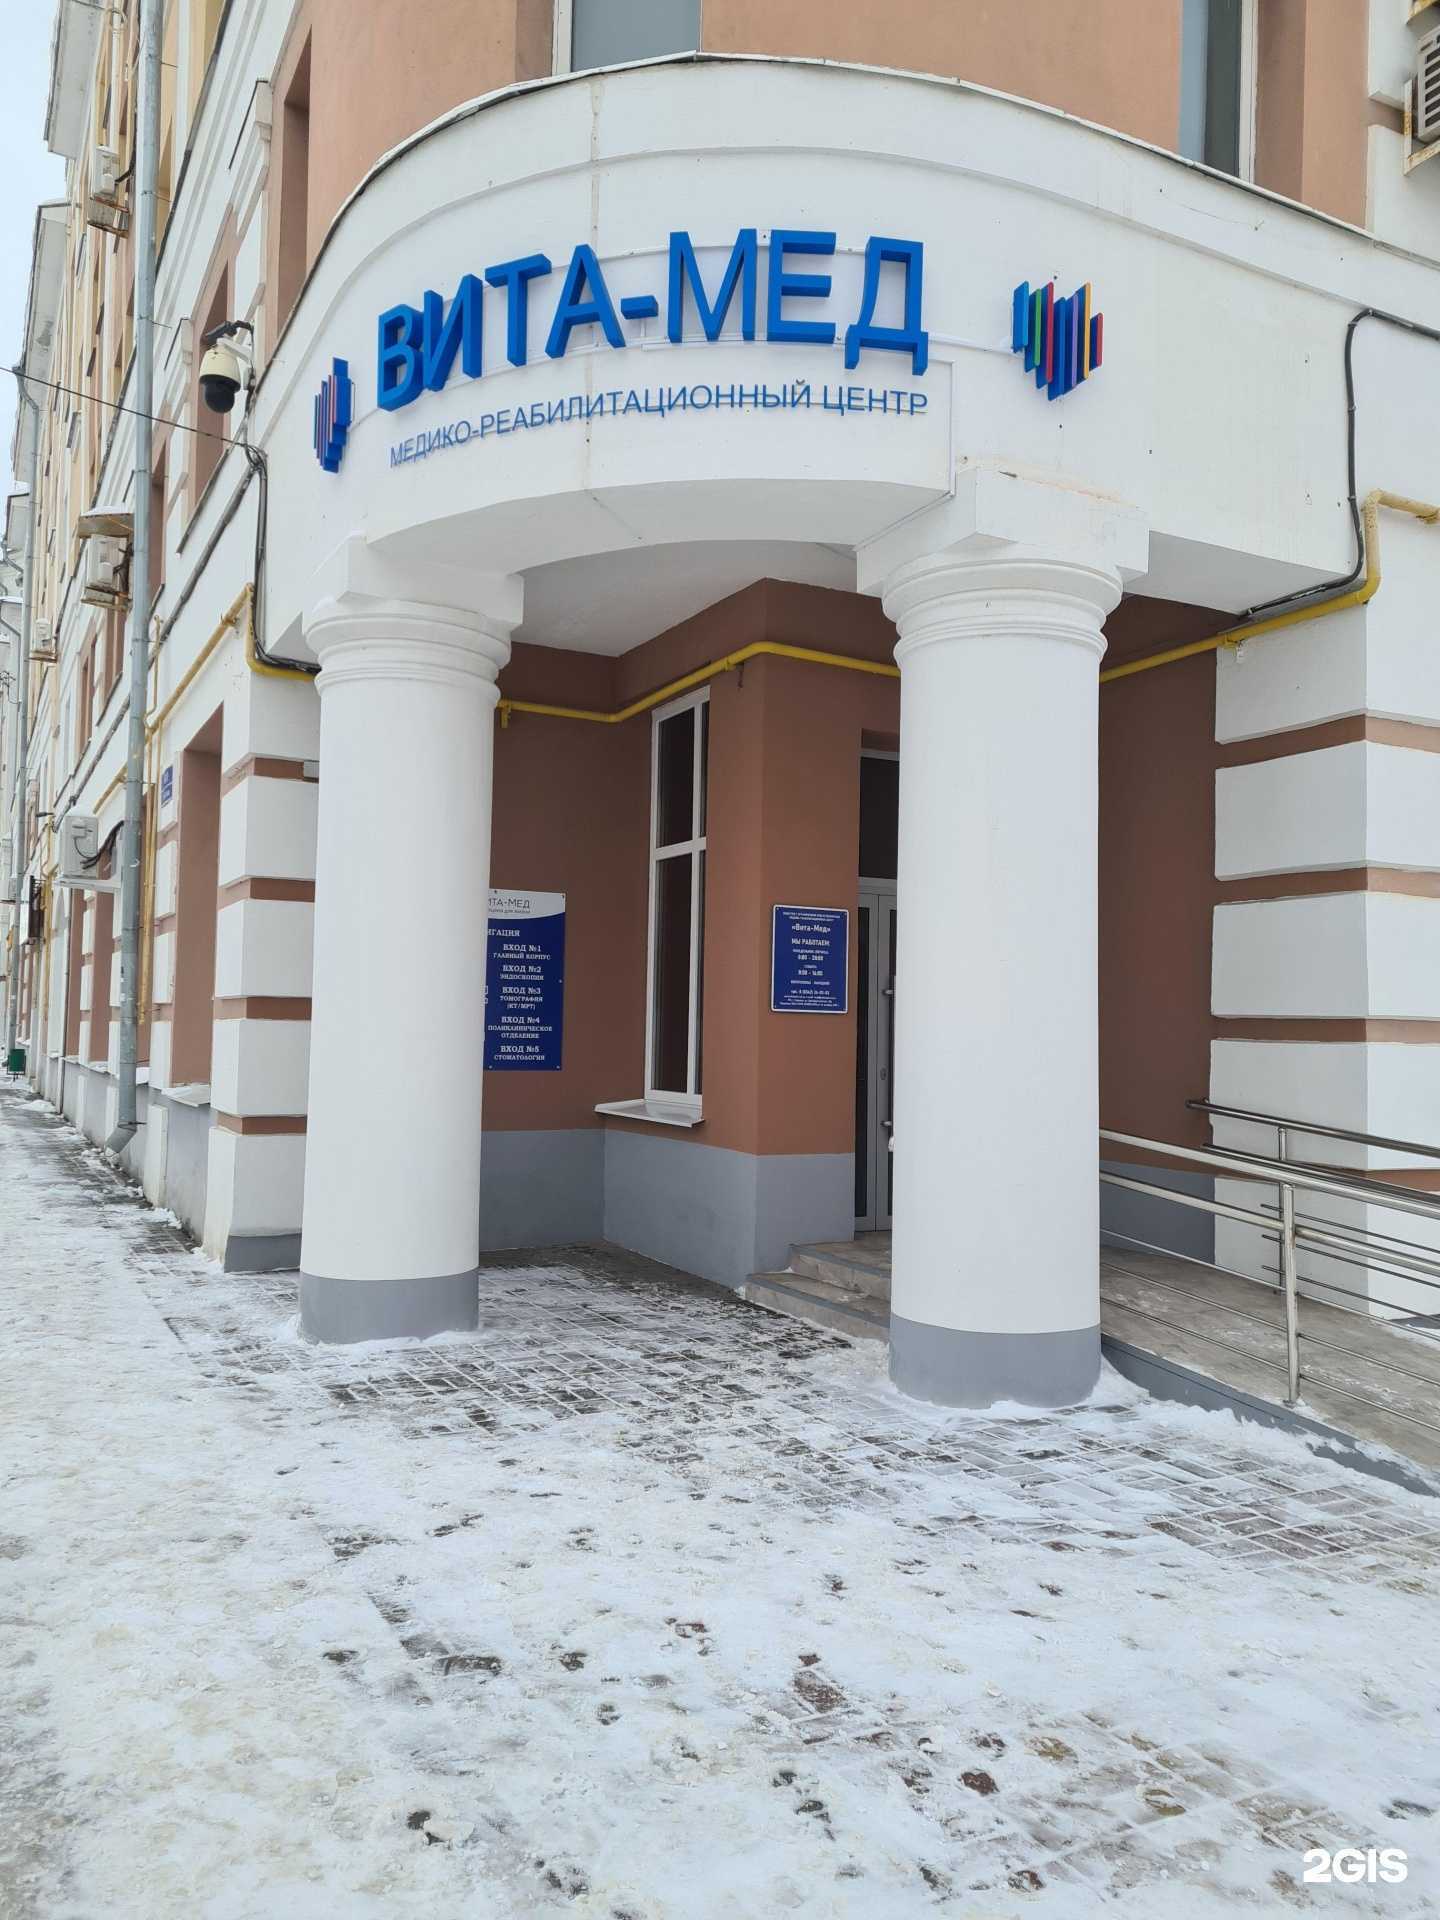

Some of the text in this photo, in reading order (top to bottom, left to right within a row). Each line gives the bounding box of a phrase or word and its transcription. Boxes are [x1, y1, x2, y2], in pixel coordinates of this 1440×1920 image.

[377, 228, 930, 412] ВИТА-МЕД
[389, 379, 928, 469] МЕДИКО-РЕАБИЛИТАЦИОННЫЙ ЦЕНТР
[503, 943, 527, 952] ВХОД
[502, 964, 526, 972] ВХОД
[502, 986, 526, 994] ВХОД
[501, 1016, 525, 1024] ВХОД
[500, 1045, 525, 1053] ВХОД
